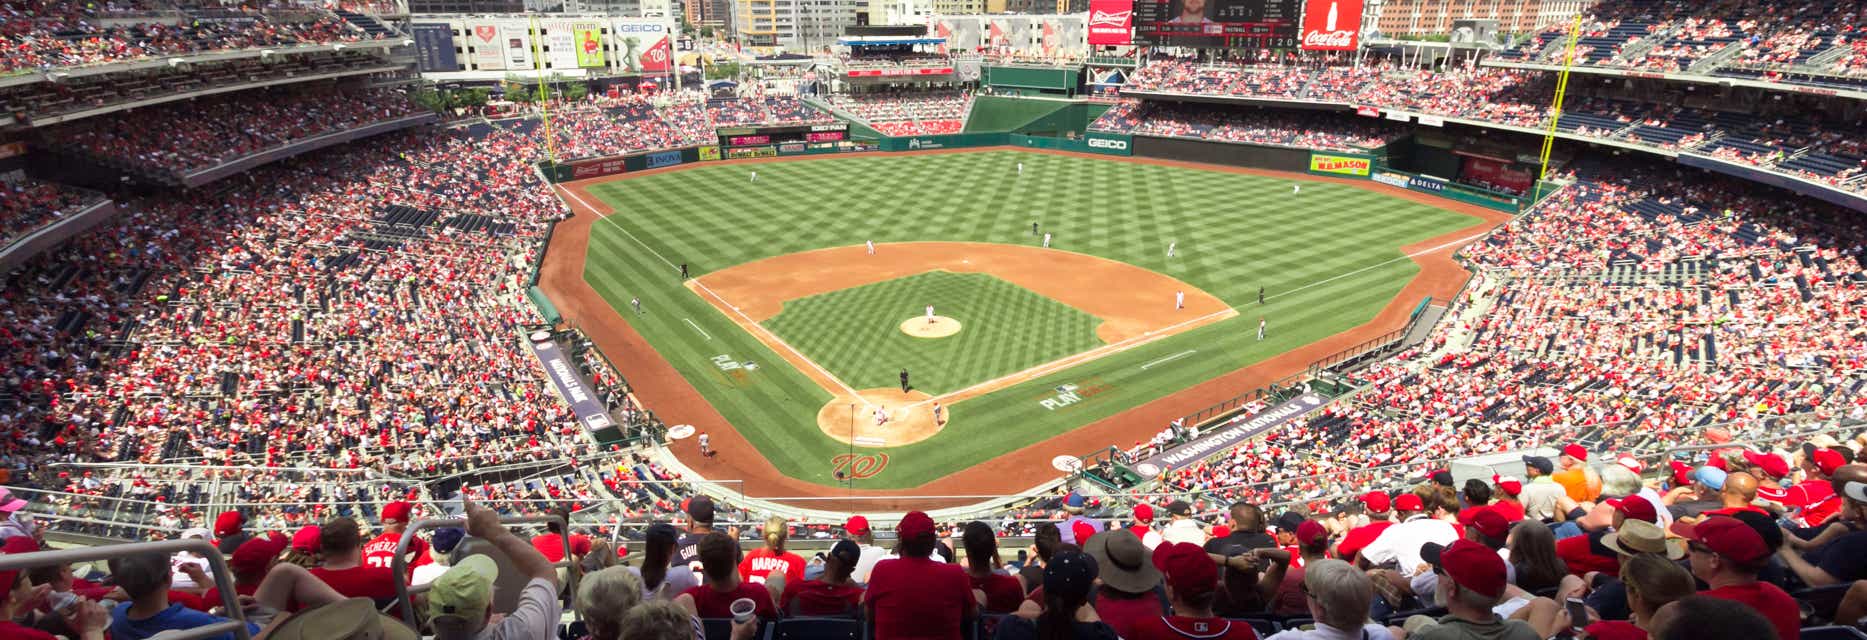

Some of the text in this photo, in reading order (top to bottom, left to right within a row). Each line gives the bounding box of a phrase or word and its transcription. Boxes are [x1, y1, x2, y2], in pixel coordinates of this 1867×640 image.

[621, 24, 662, 32] GEICO
[1088, 138, 1127, 150] GEICO
[1417, 179, 1441, 190] DELTA
[1040, 391, 1082, 410] PLAY
[1162, 403, 1303, 465] WASHINGTON NATIONALS
[365, 541, 398, 556] SCHERZ
[753, 557, 789, 574] HARPER
